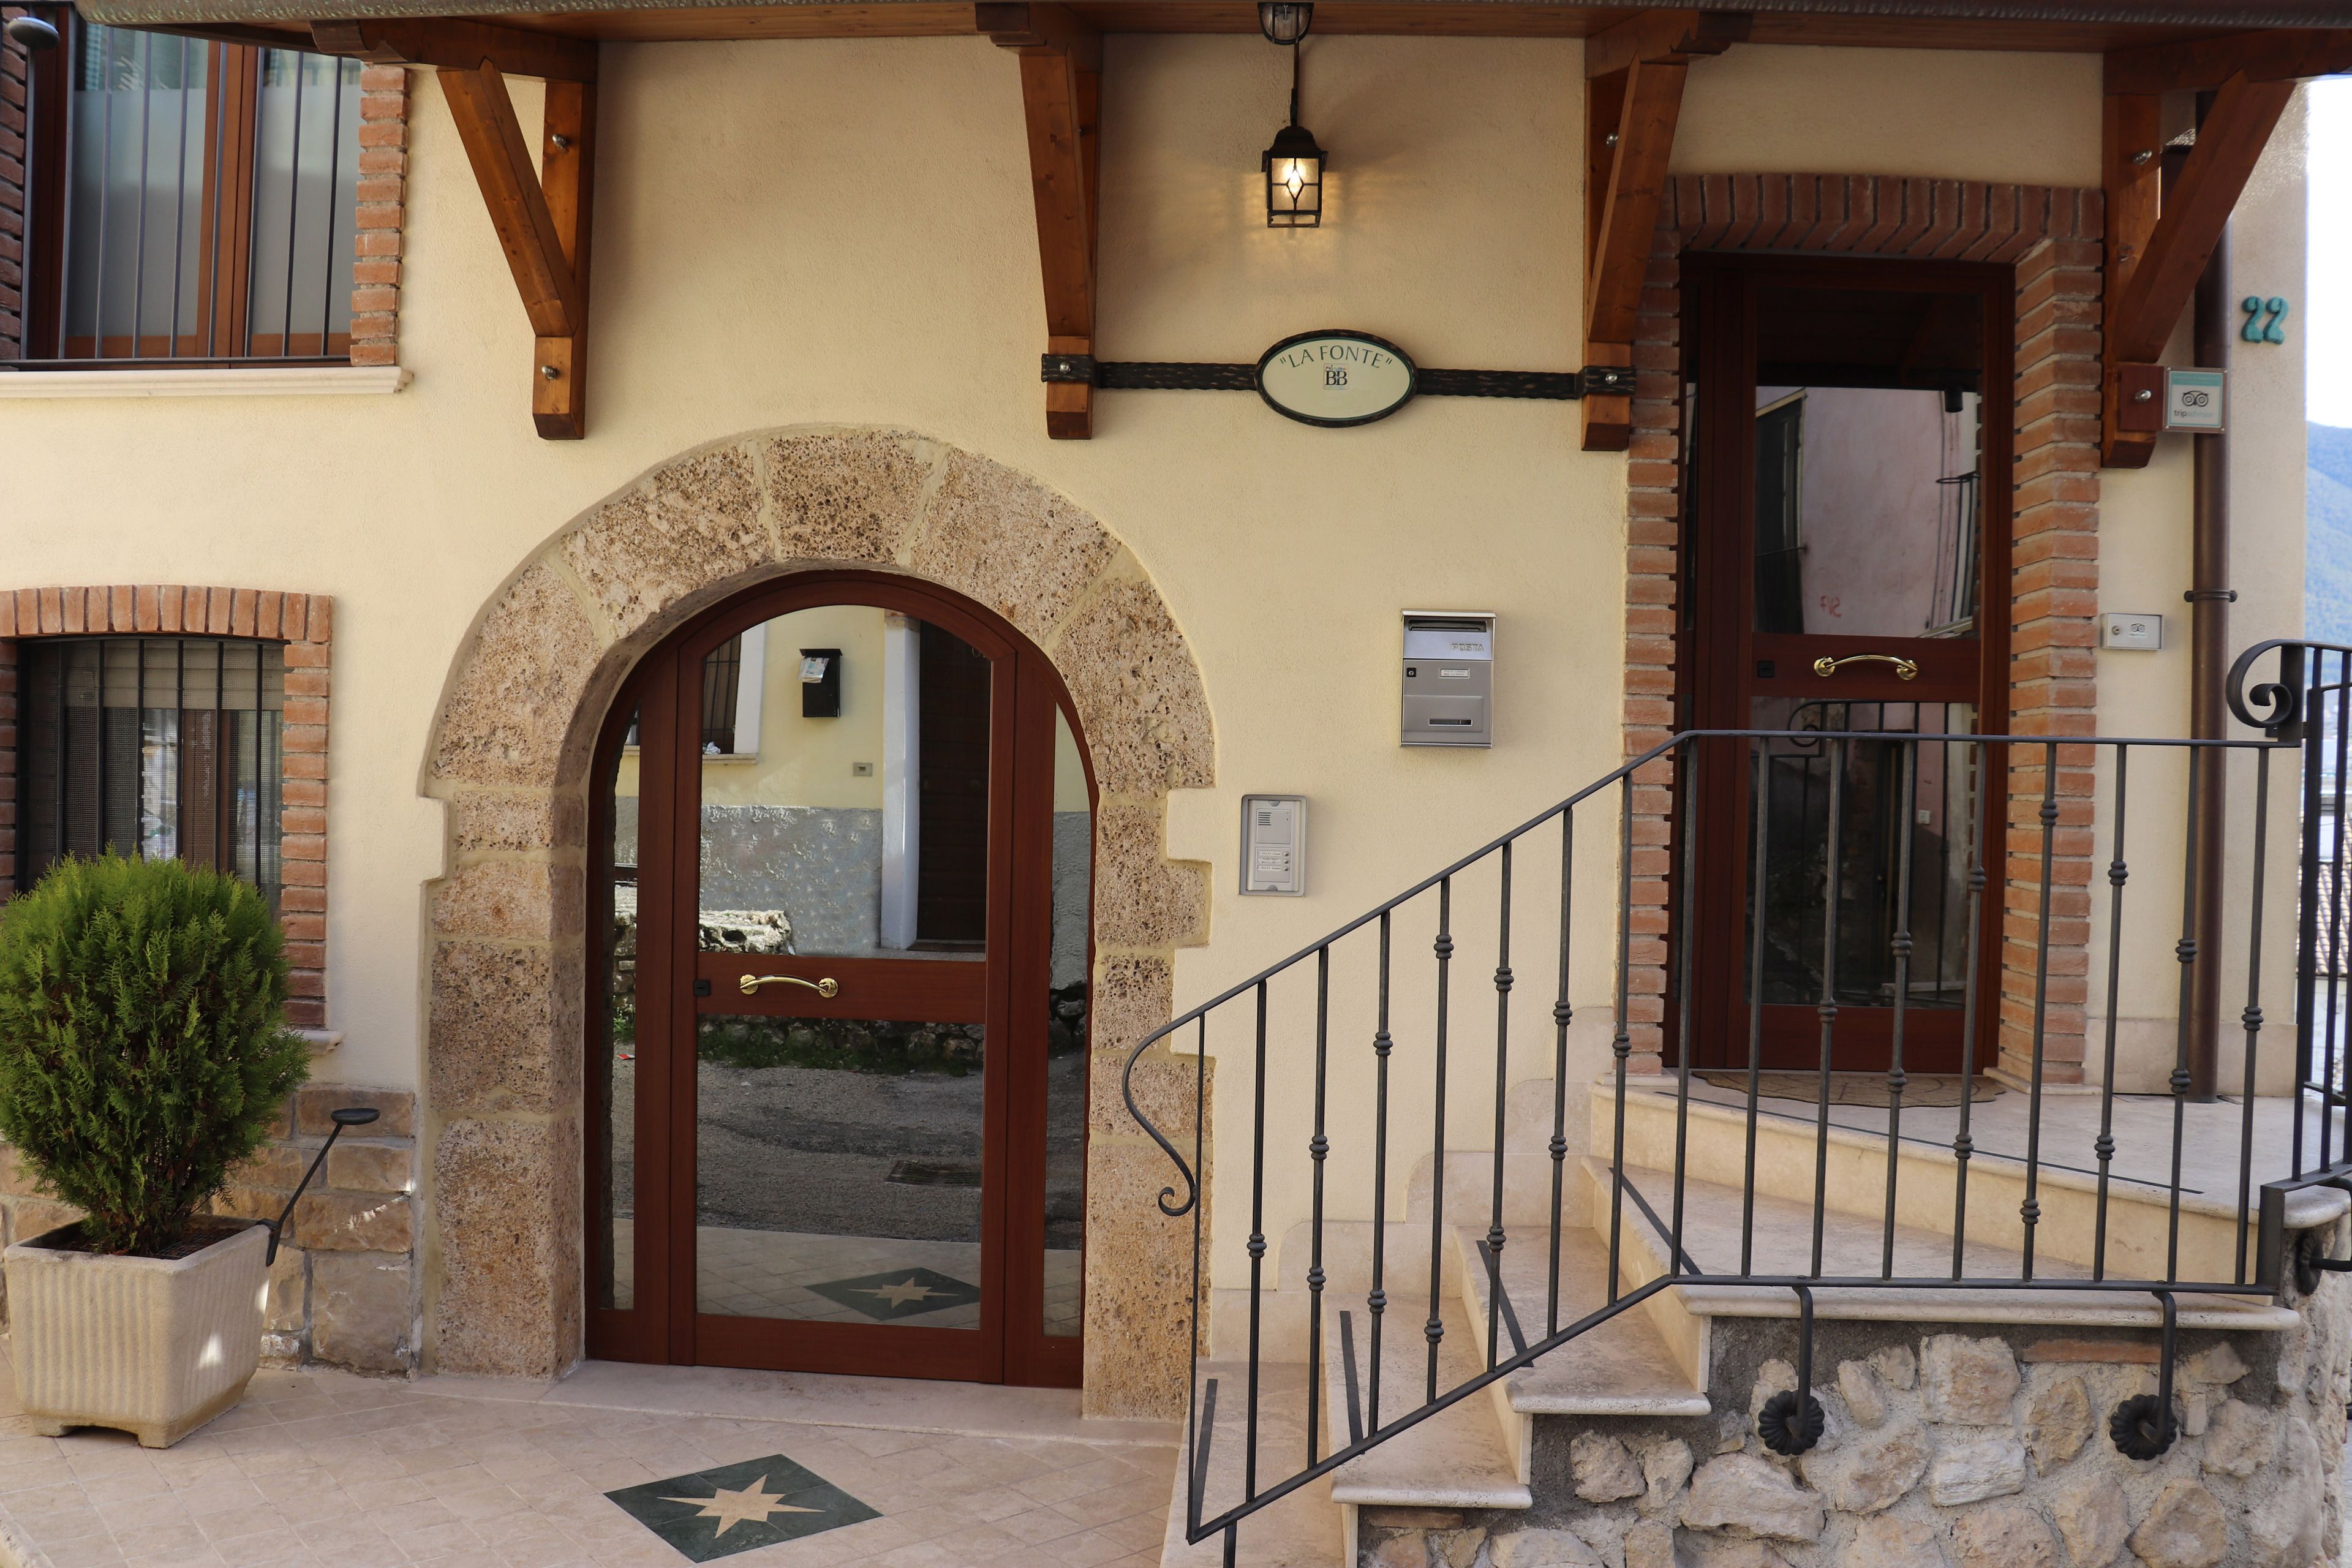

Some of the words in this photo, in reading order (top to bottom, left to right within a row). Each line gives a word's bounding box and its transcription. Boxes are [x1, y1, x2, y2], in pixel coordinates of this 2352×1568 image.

[2241, 296, 2289, 345] 22
[2174, 410, 2214, 418] tripadvisor
[1450, 643, 1485, 652] POSTA
